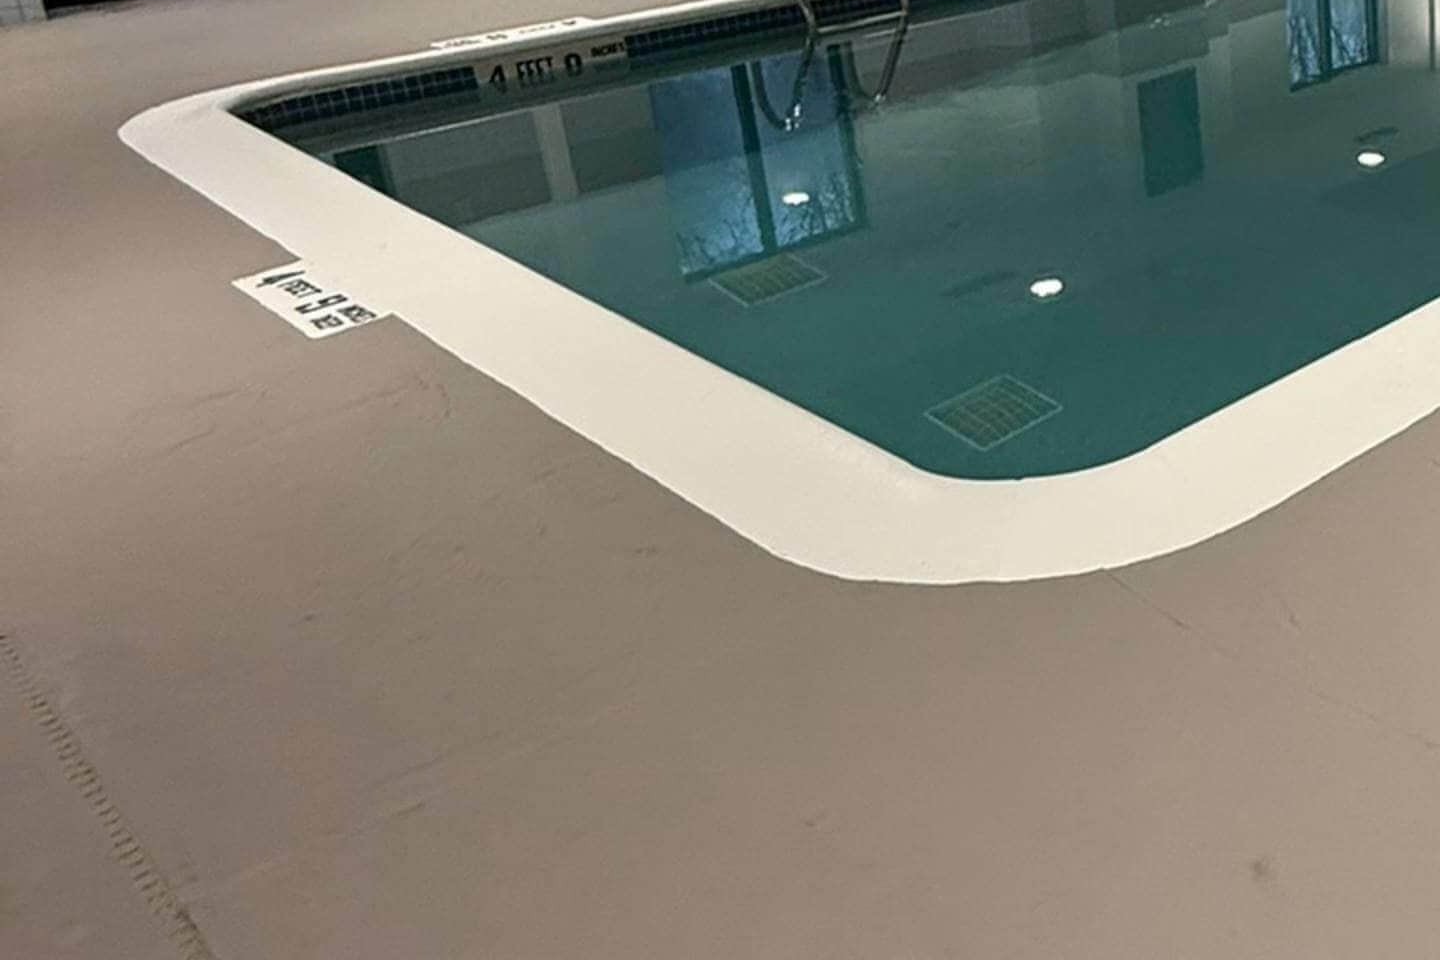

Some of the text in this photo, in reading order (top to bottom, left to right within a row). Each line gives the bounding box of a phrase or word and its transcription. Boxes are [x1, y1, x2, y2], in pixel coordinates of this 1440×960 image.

[516, 56, 553, 82] FEET
[277, 278, 322, 298] FEET
[295, 294, 348, 314] 9
